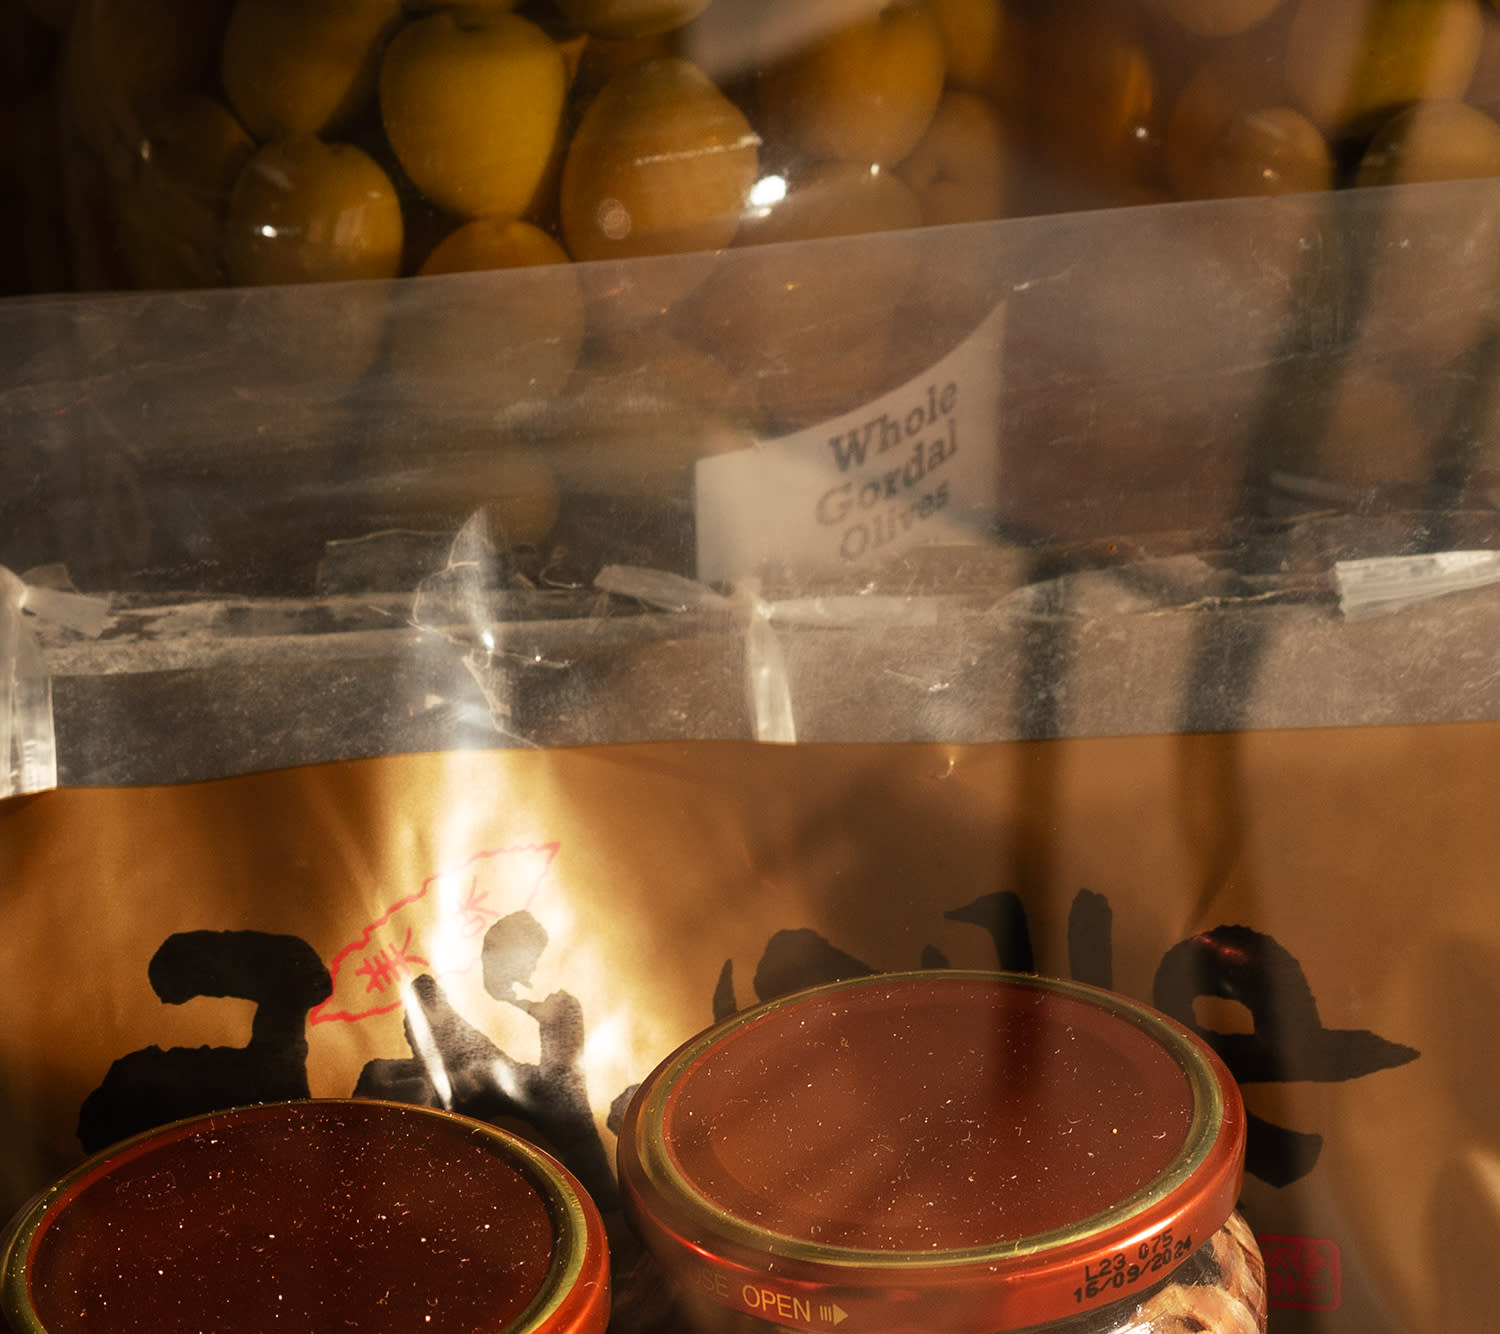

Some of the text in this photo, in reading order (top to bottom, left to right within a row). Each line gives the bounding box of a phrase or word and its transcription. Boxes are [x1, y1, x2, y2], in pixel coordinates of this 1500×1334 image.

[827, 380, 958, 473] Whole
[815, 417, 959, 528] Gordal
[839, 480, 950, 562] Olives
[1073, 1235, 1192, 1303] 16/09/2024
[1085, 1228, 1173, 1282] L23 075
[742, 1285, 812, 1322] OPEN
